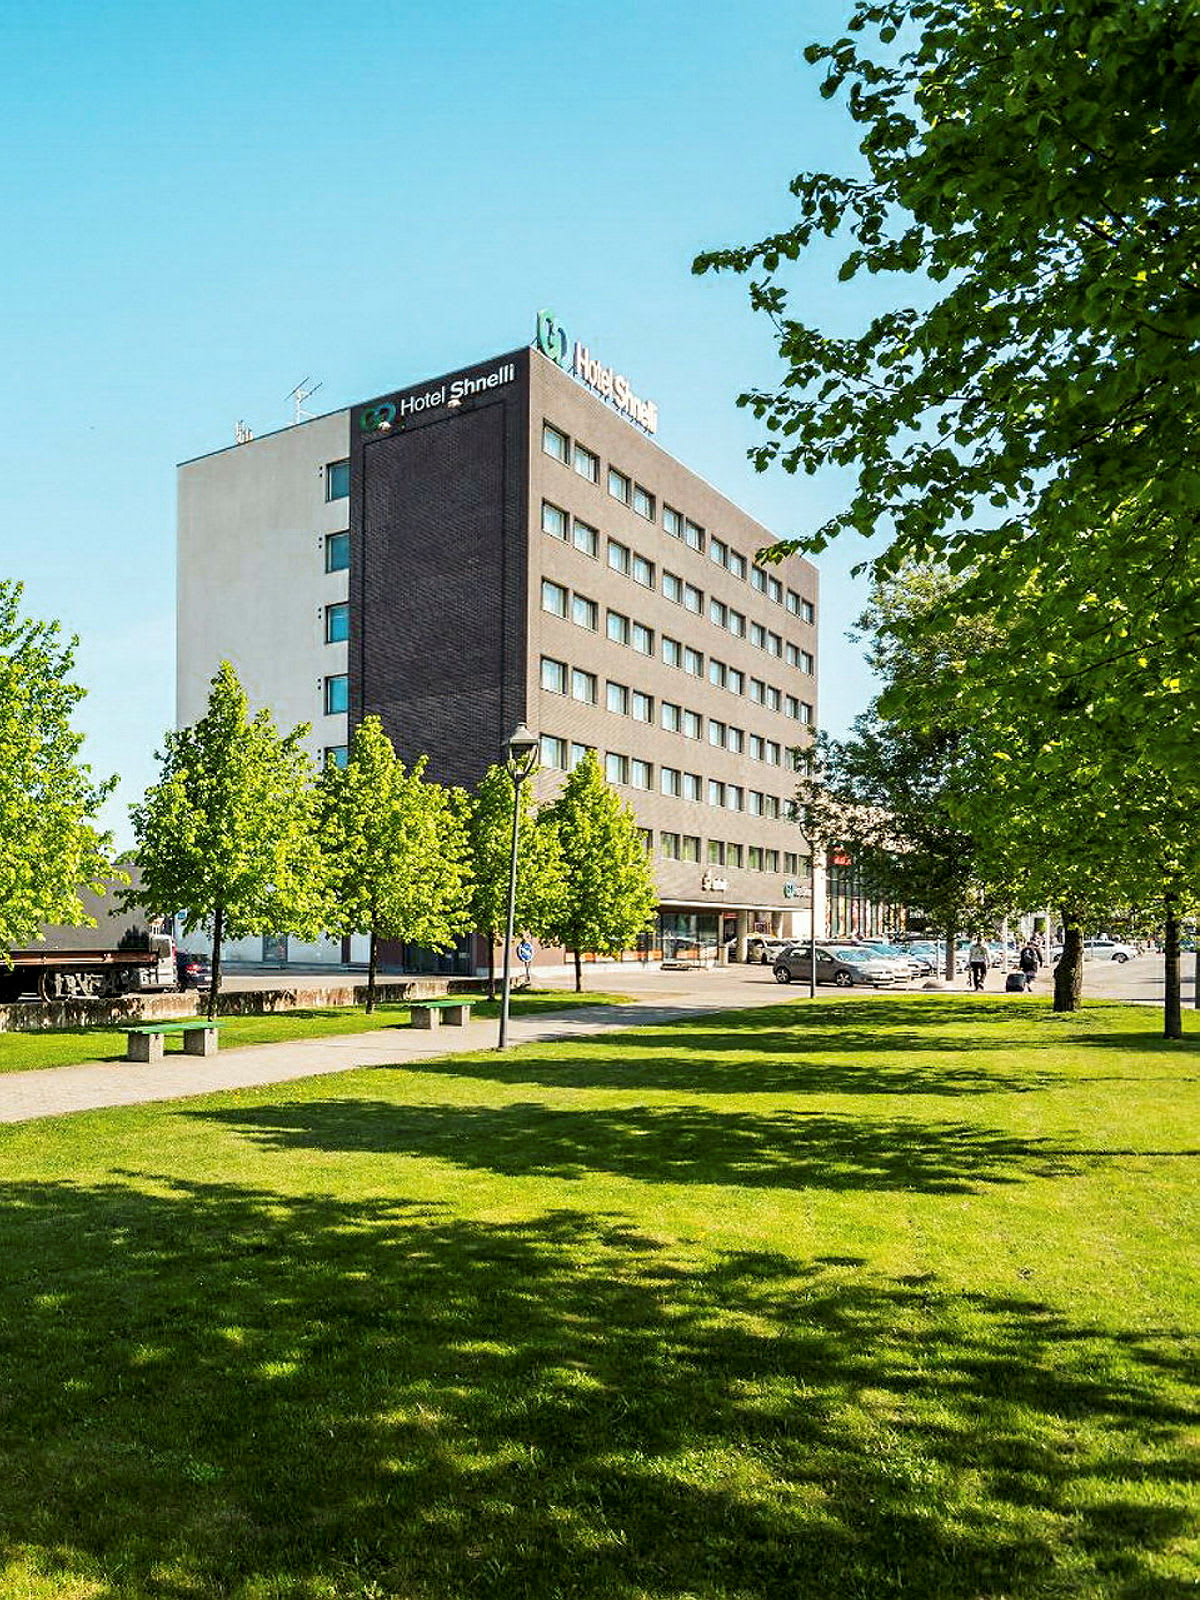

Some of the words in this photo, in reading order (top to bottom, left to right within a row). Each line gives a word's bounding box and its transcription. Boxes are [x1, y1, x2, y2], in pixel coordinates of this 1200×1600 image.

[400, 385, 446, 416] Hotel
[450, 363, 515, 399] Shnelli
[574, 340, 613, 396] Hotel
